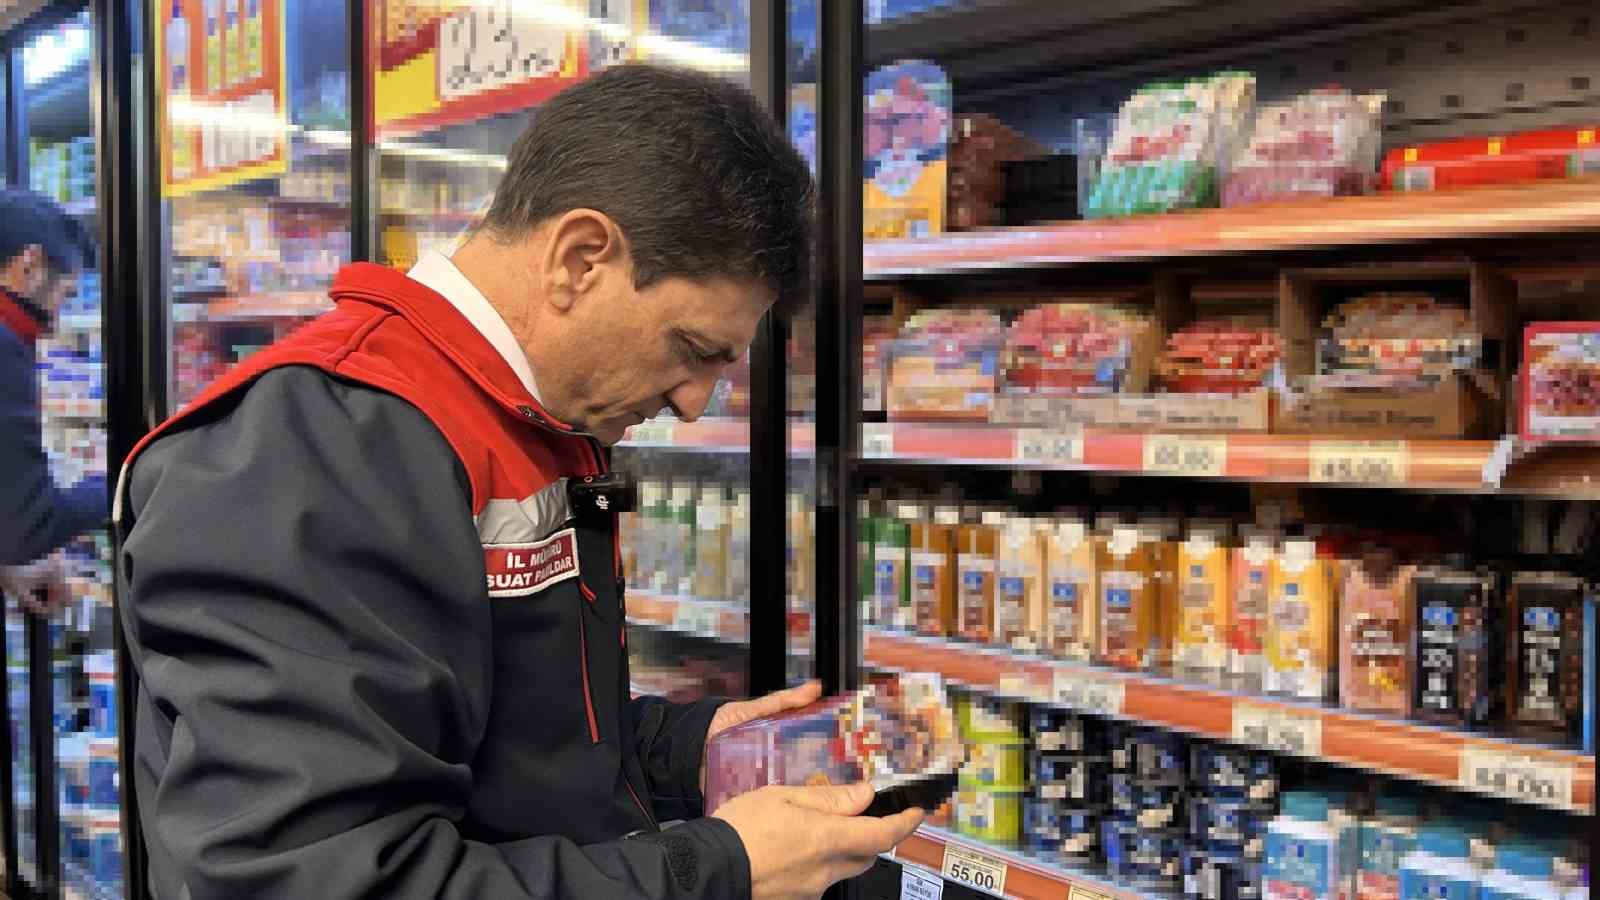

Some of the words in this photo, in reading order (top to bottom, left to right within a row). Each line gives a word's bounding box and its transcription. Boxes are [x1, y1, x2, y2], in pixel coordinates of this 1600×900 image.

[507, 552, 526, 568] İL
[486, 571, 533, 588] SUAT
[950, 863, 994, 890] 55,00
